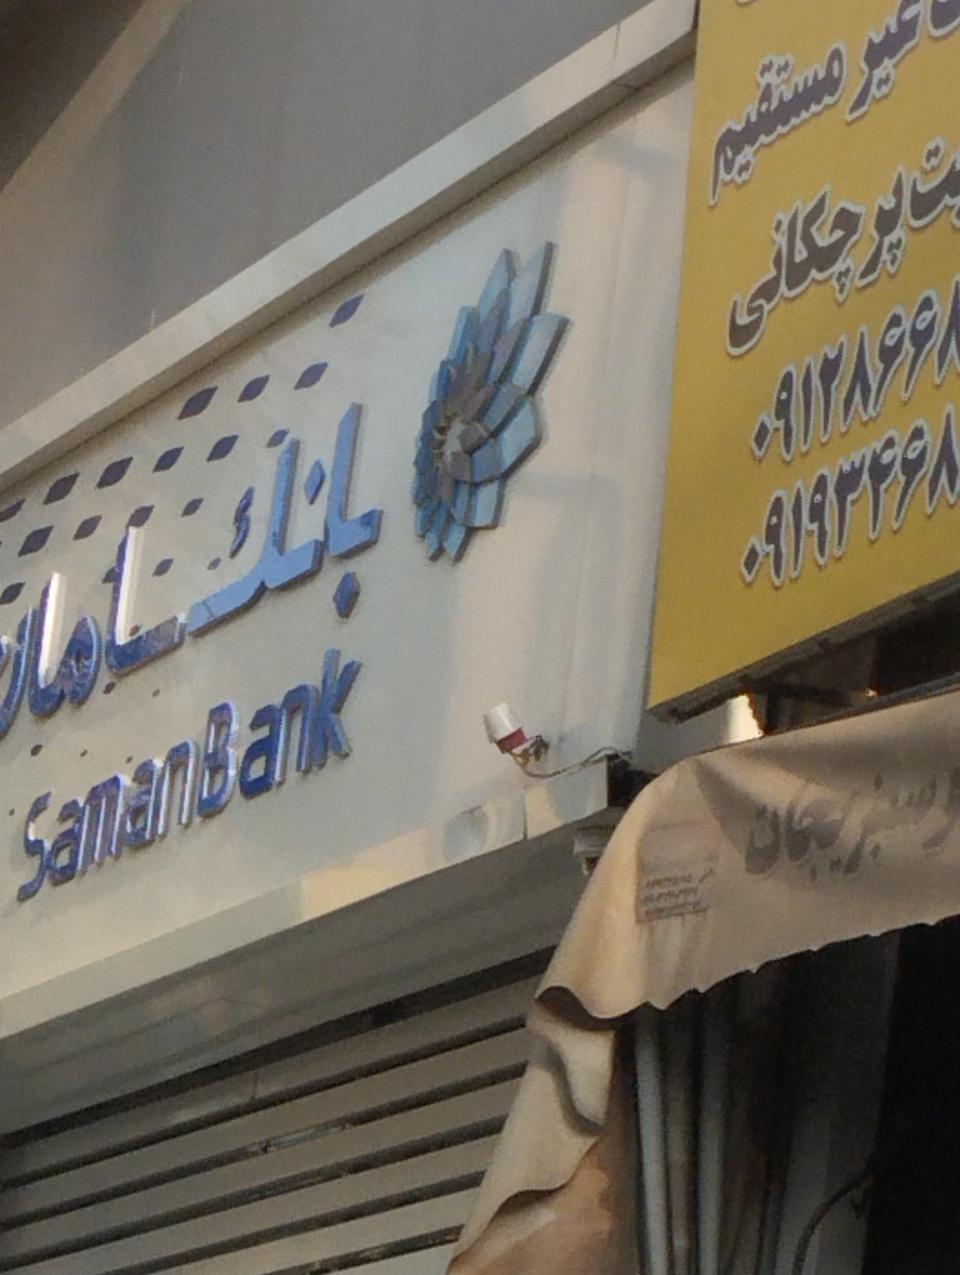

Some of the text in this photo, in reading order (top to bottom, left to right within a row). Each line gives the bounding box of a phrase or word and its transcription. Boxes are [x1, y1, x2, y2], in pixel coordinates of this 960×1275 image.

[709, 42, 846, 207] مستقیم
[186, 402, 384, 636] بانک
[16, 646, 363, 903] SamanBank
